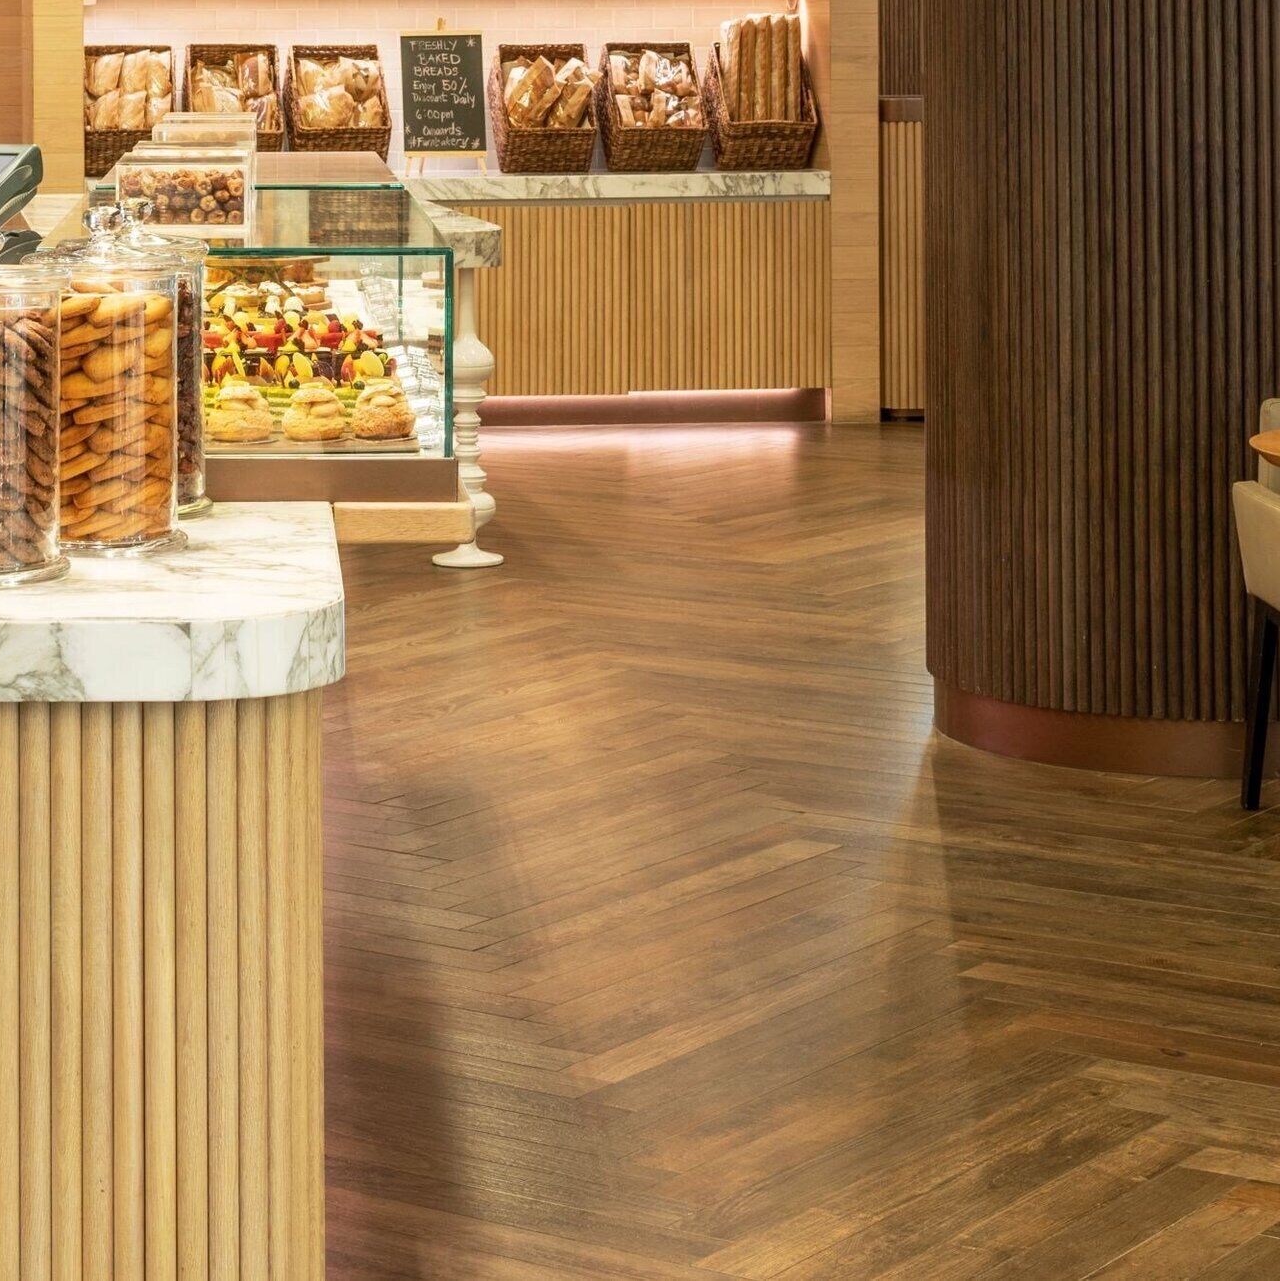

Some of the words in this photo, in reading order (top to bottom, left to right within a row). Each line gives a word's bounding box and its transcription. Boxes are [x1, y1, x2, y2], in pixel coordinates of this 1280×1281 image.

[409, 40, 458, 52] FRESHLY
[417, 53, 461, 66] BAKED
[414, 66, 459, 77] BREADS
[413, 78, 436, 95] Enjoy
[450, 91, 476, 109] Daily
[415, 109, 454, 123] 6:00pm
